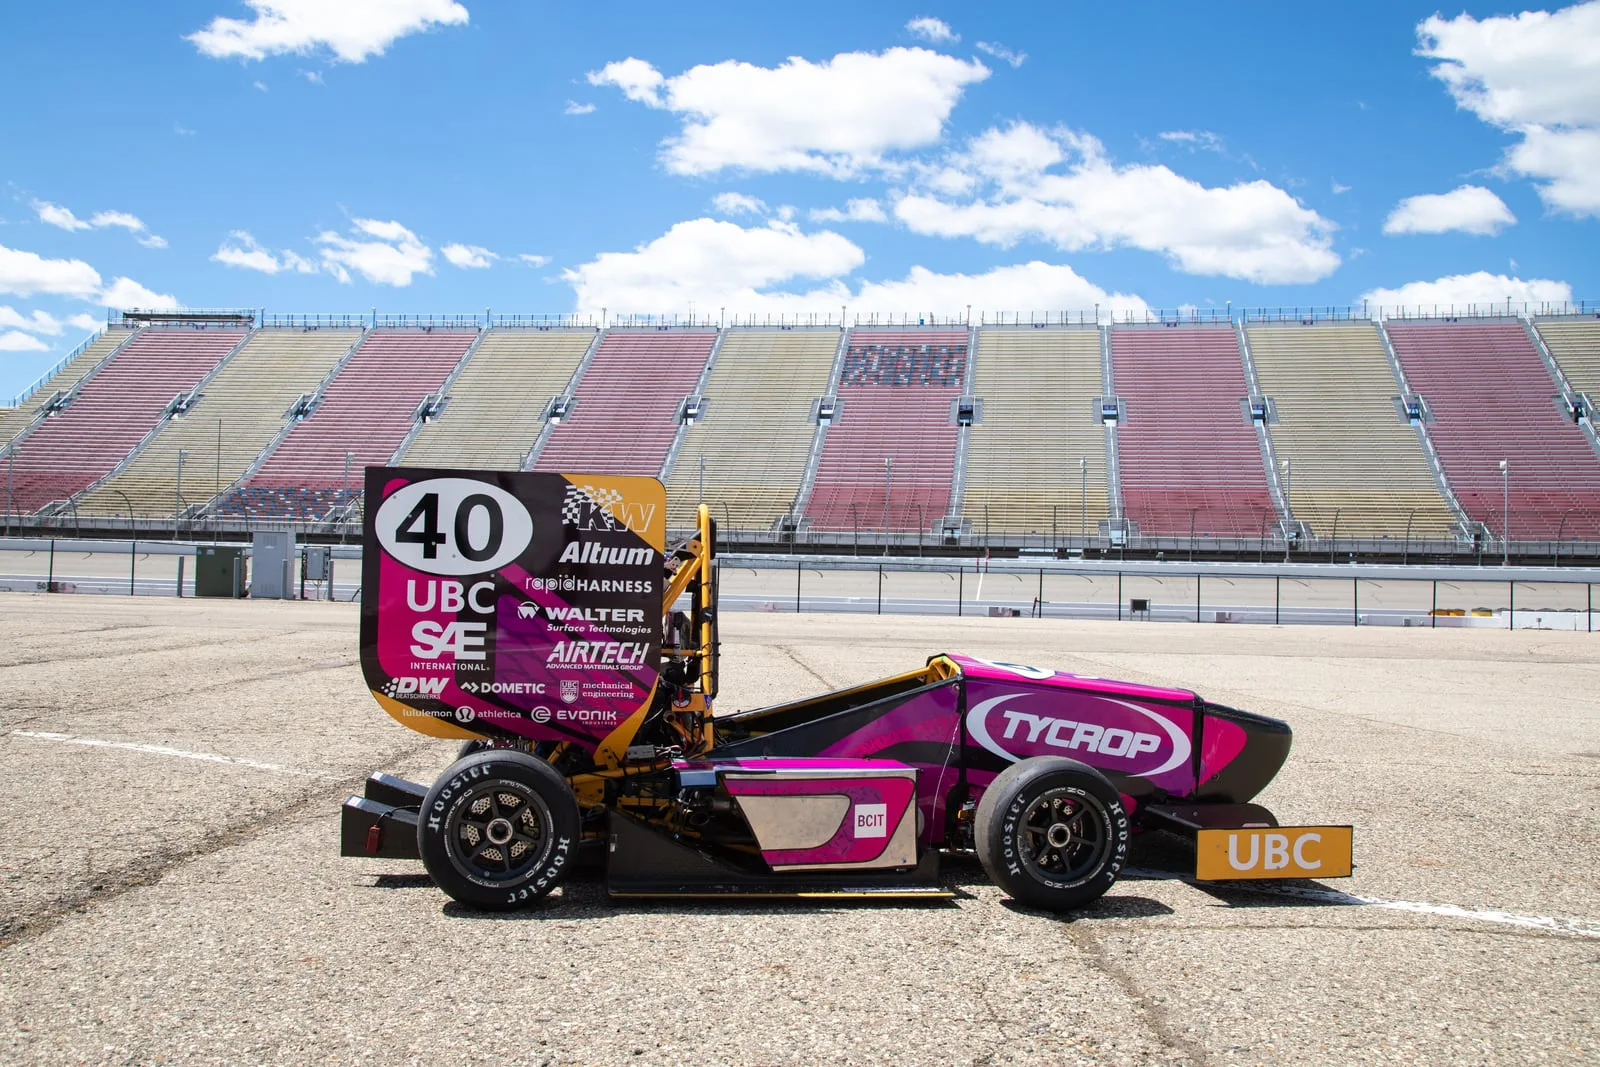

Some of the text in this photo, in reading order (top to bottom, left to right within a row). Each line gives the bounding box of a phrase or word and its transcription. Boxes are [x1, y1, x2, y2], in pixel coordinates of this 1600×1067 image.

[395, 493, 504, 562] 40
[576, 501, 656, 532] KW
[558, 541, 655, 566] Altium
[406, 579, 496, 614] UBC
[545, 607, 645, 622] WALTER
[409, 620, 488, 660] SAE
[546, 623, 652, 635] Surface Technologies
[546, 640, 650, 665] AIRTECH
[396, 676, 450, 693] DW
[480, 682, 546, 694] DOMETIC
[562, 680, 578, 688] UBC
[582, 681, 633, 690] mechanical
[582, 691, 635, 699] engineering
[402, 709, 522, 719] lululemon athletica
[556, 710, 617, 720] EVONIK
[1002, 710, 1162, 759] TYCROP
[428, 763, 492, 834] Hoosier
[857, 813, 885, 828] BCIT
[1003, 793, 1026, 876] Hoosier
[1105, 801, 1128, 882] Hoosier
[1228, 832, 1322, 871] UBC
[507, 836, 571, 904] Hoosier
